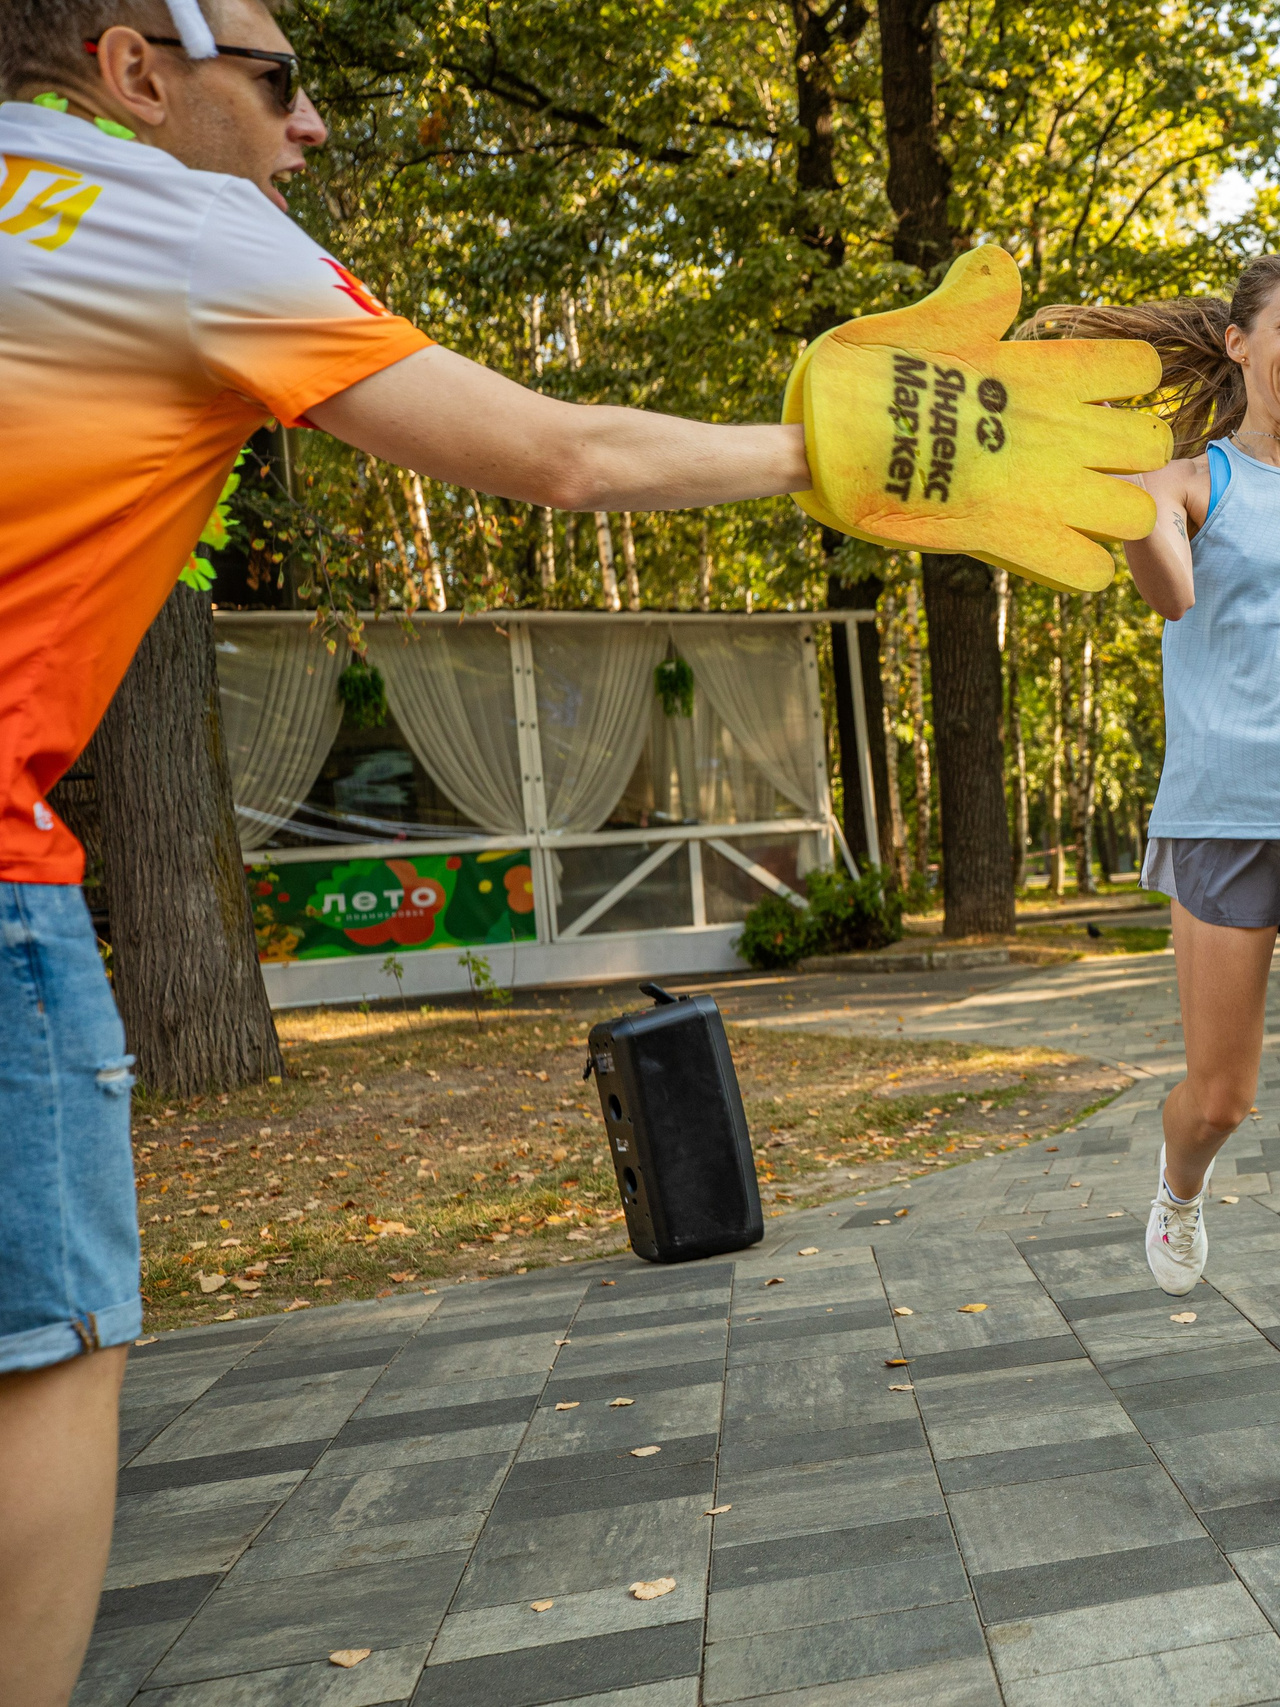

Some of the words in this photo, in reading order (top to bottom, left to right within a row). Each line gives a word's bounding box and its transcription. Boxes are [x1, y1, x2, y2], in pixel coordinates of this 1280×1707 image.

[885, 354, 928, 502] Маркет
[924, 365, 966, 503] Яндекс
[322, 887, 437, 914] лето
